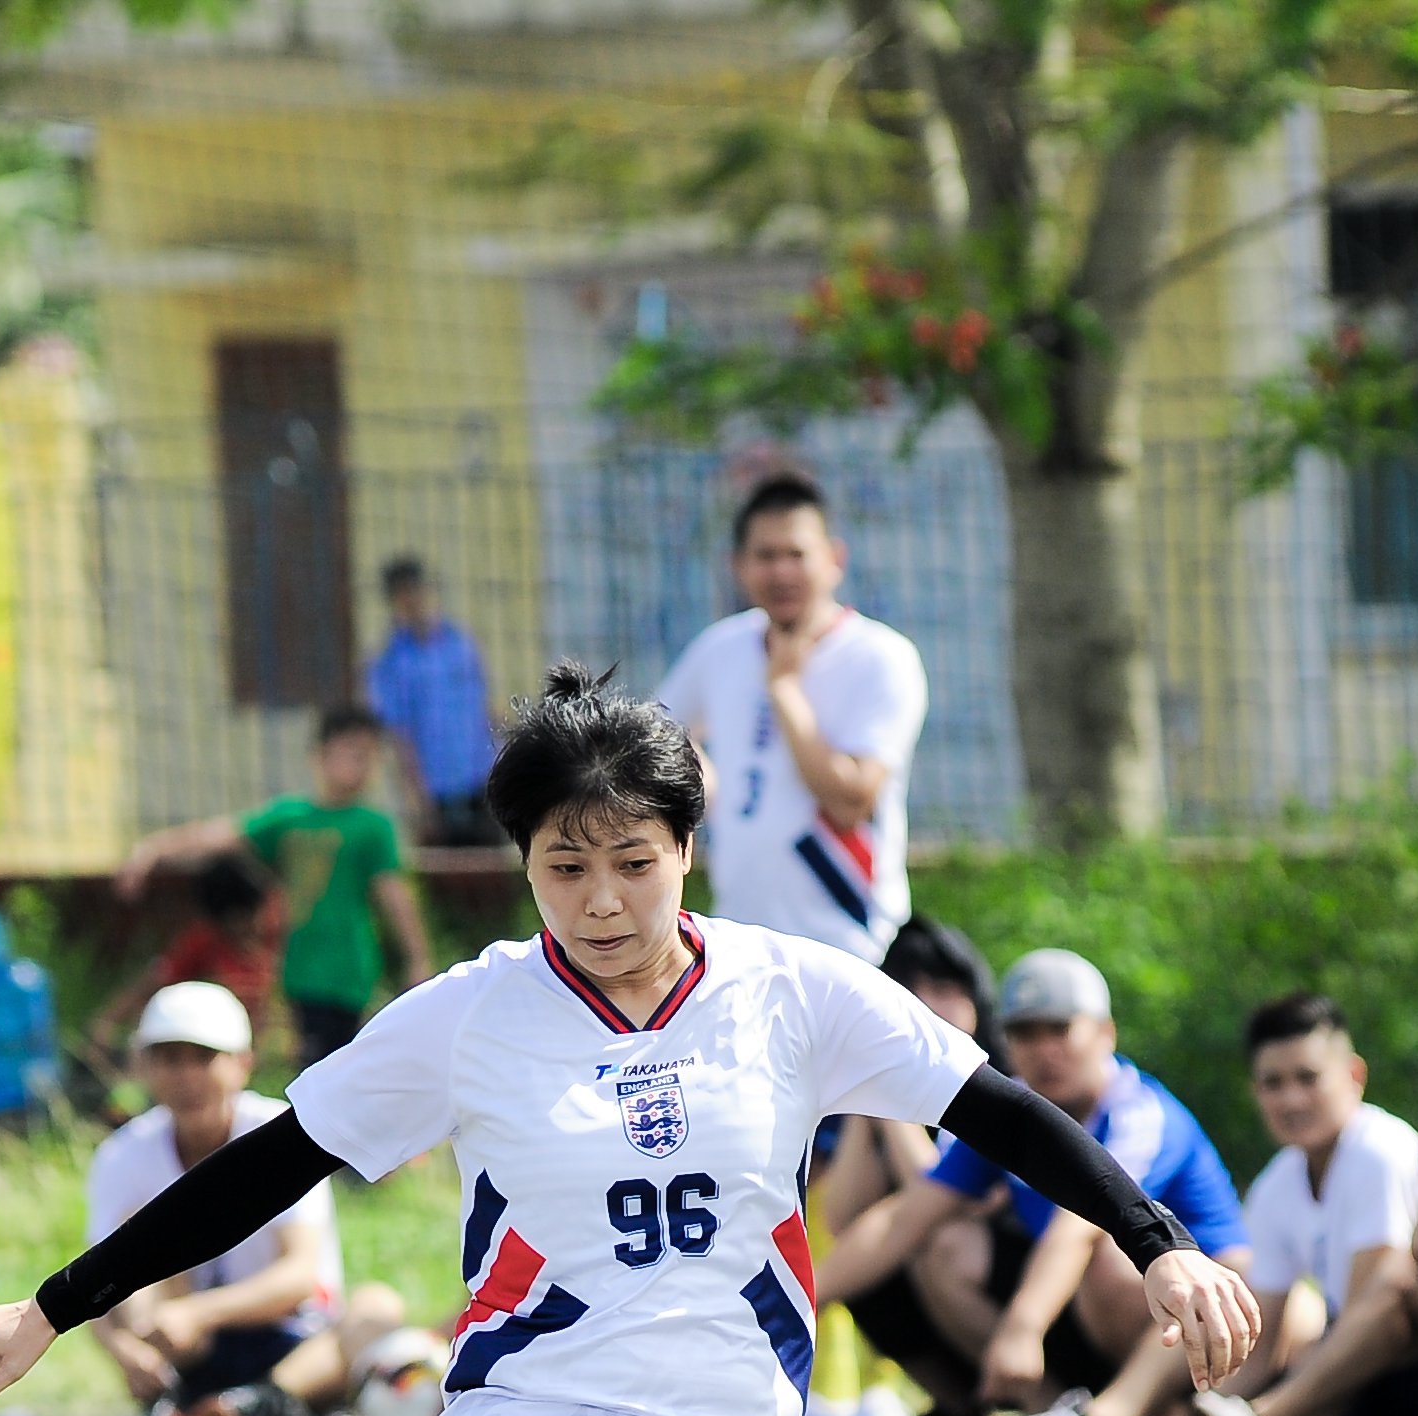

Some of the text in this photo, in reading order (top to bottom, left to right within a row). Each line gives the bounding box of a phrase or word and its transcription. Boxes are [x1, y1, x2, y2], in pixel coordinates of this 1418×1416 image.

[623, 1056, 695, 1077] TAKAHATA
[621, 1075, 676, 1094] ENGLAND
[606, 1173, 721, 1271] 96
